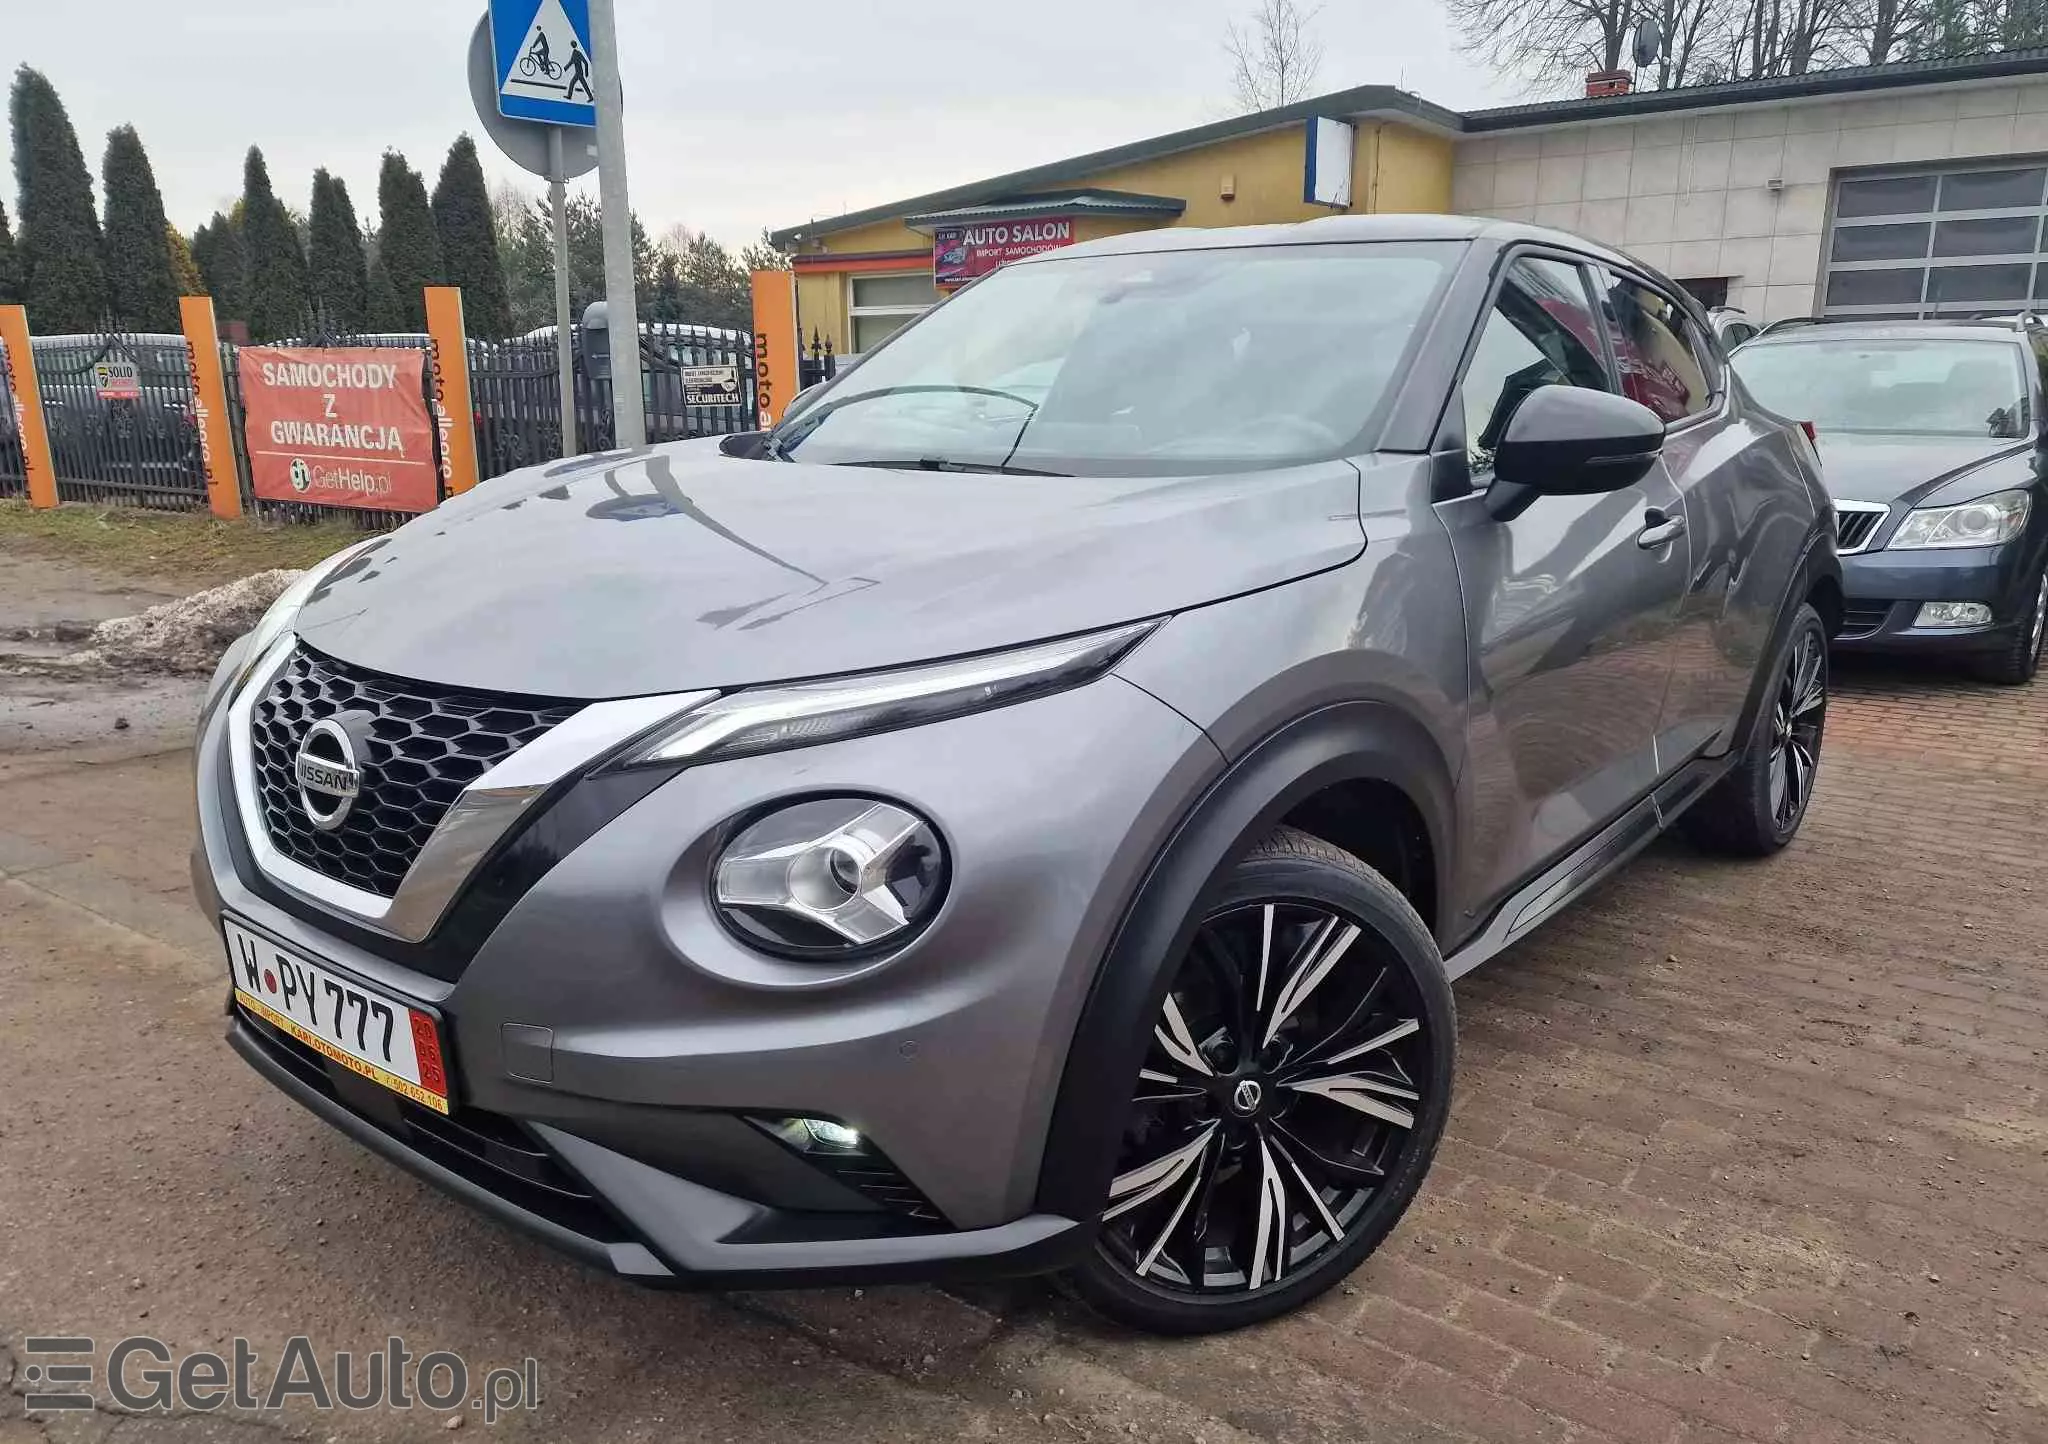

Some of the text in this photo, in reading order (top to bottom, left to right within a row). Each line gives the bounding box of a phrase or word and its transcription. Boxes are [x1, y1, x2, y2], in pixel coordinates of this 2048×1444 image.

[963, 227, 1009, 246] AUTO
[1012, 222, 1070, 242] SALON
[976, 247, 1003, 258] IMPORT
[262, 362, 397, 389] SAMOCHODY
[323, 394, 337, 418] Z
[686, 393, 740, 404] SECURITECH
[271, 420, 405, 458] GWARANCJĄ
[312, 464, 392, 497] GetHelp.pl
[300, 763, 356, 791] NISSAN
[237, 932, 262, 993] W
